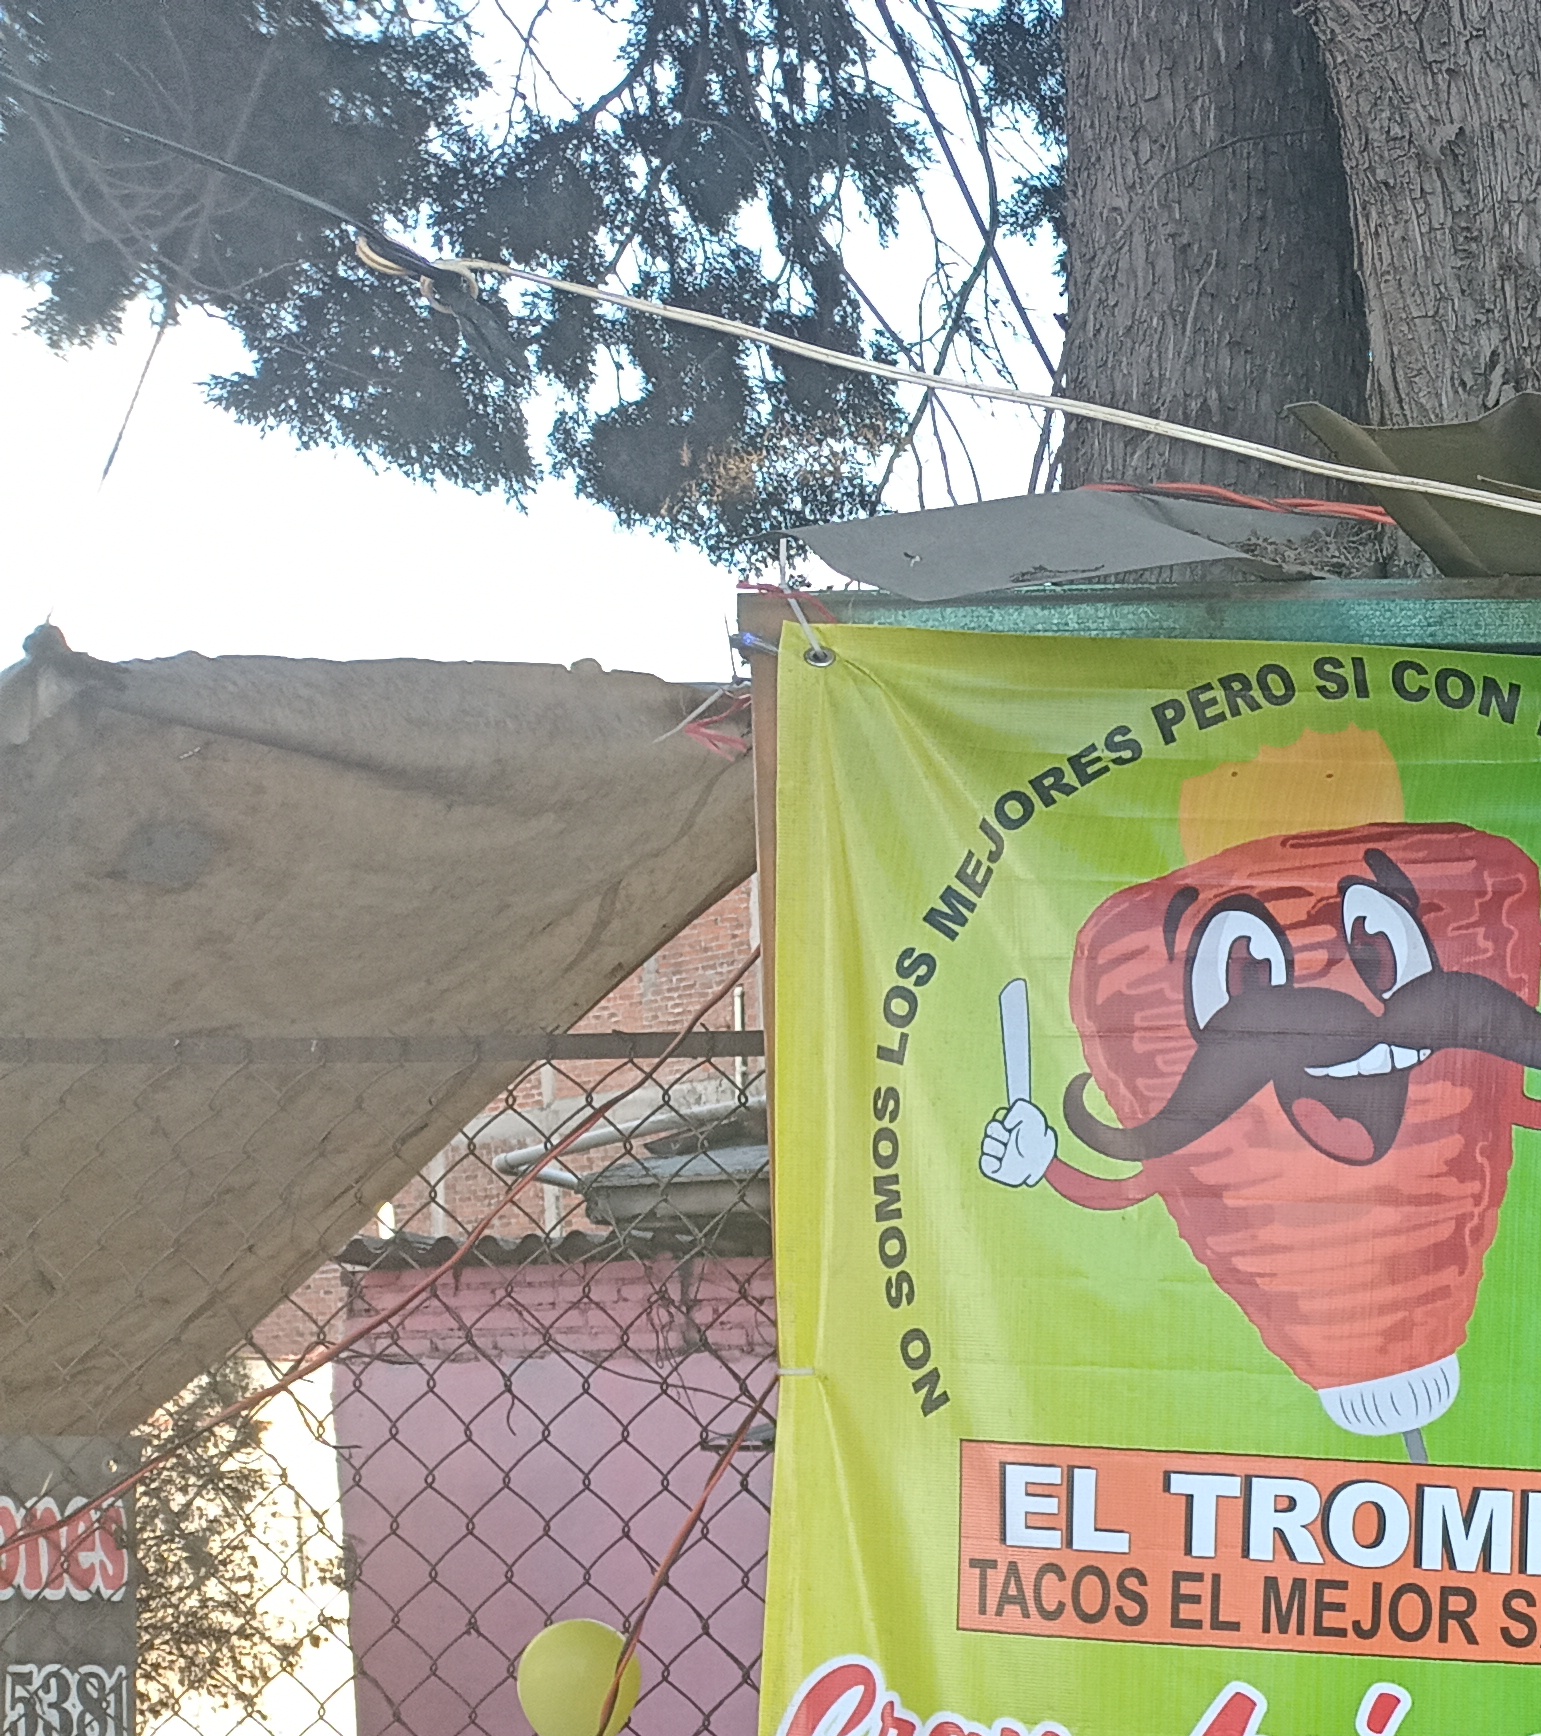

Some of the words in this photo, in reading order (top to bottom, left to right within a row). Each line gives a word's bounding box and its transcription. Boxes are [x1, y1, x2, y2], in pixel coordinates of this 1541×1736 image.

[1150, 661, 1297, 746] PERO
[1315, 655, 1371, 701] SI
[1391, 659, 1523, 725] CON
[922, 723, 1144, 942] MEJORES
[876, 945, 937, 1066] LOS
[871, 1086, 917, 1310] SOMOS
[899, 1327, 951, 1417] NO
[998, 1462, 1132, 1554] EL
[970, 1557, 1149, 1626] TACOS
[1171, 1569, 1243, 1633] EL
[1263, 1576, 1480, 1647] MEJOR
